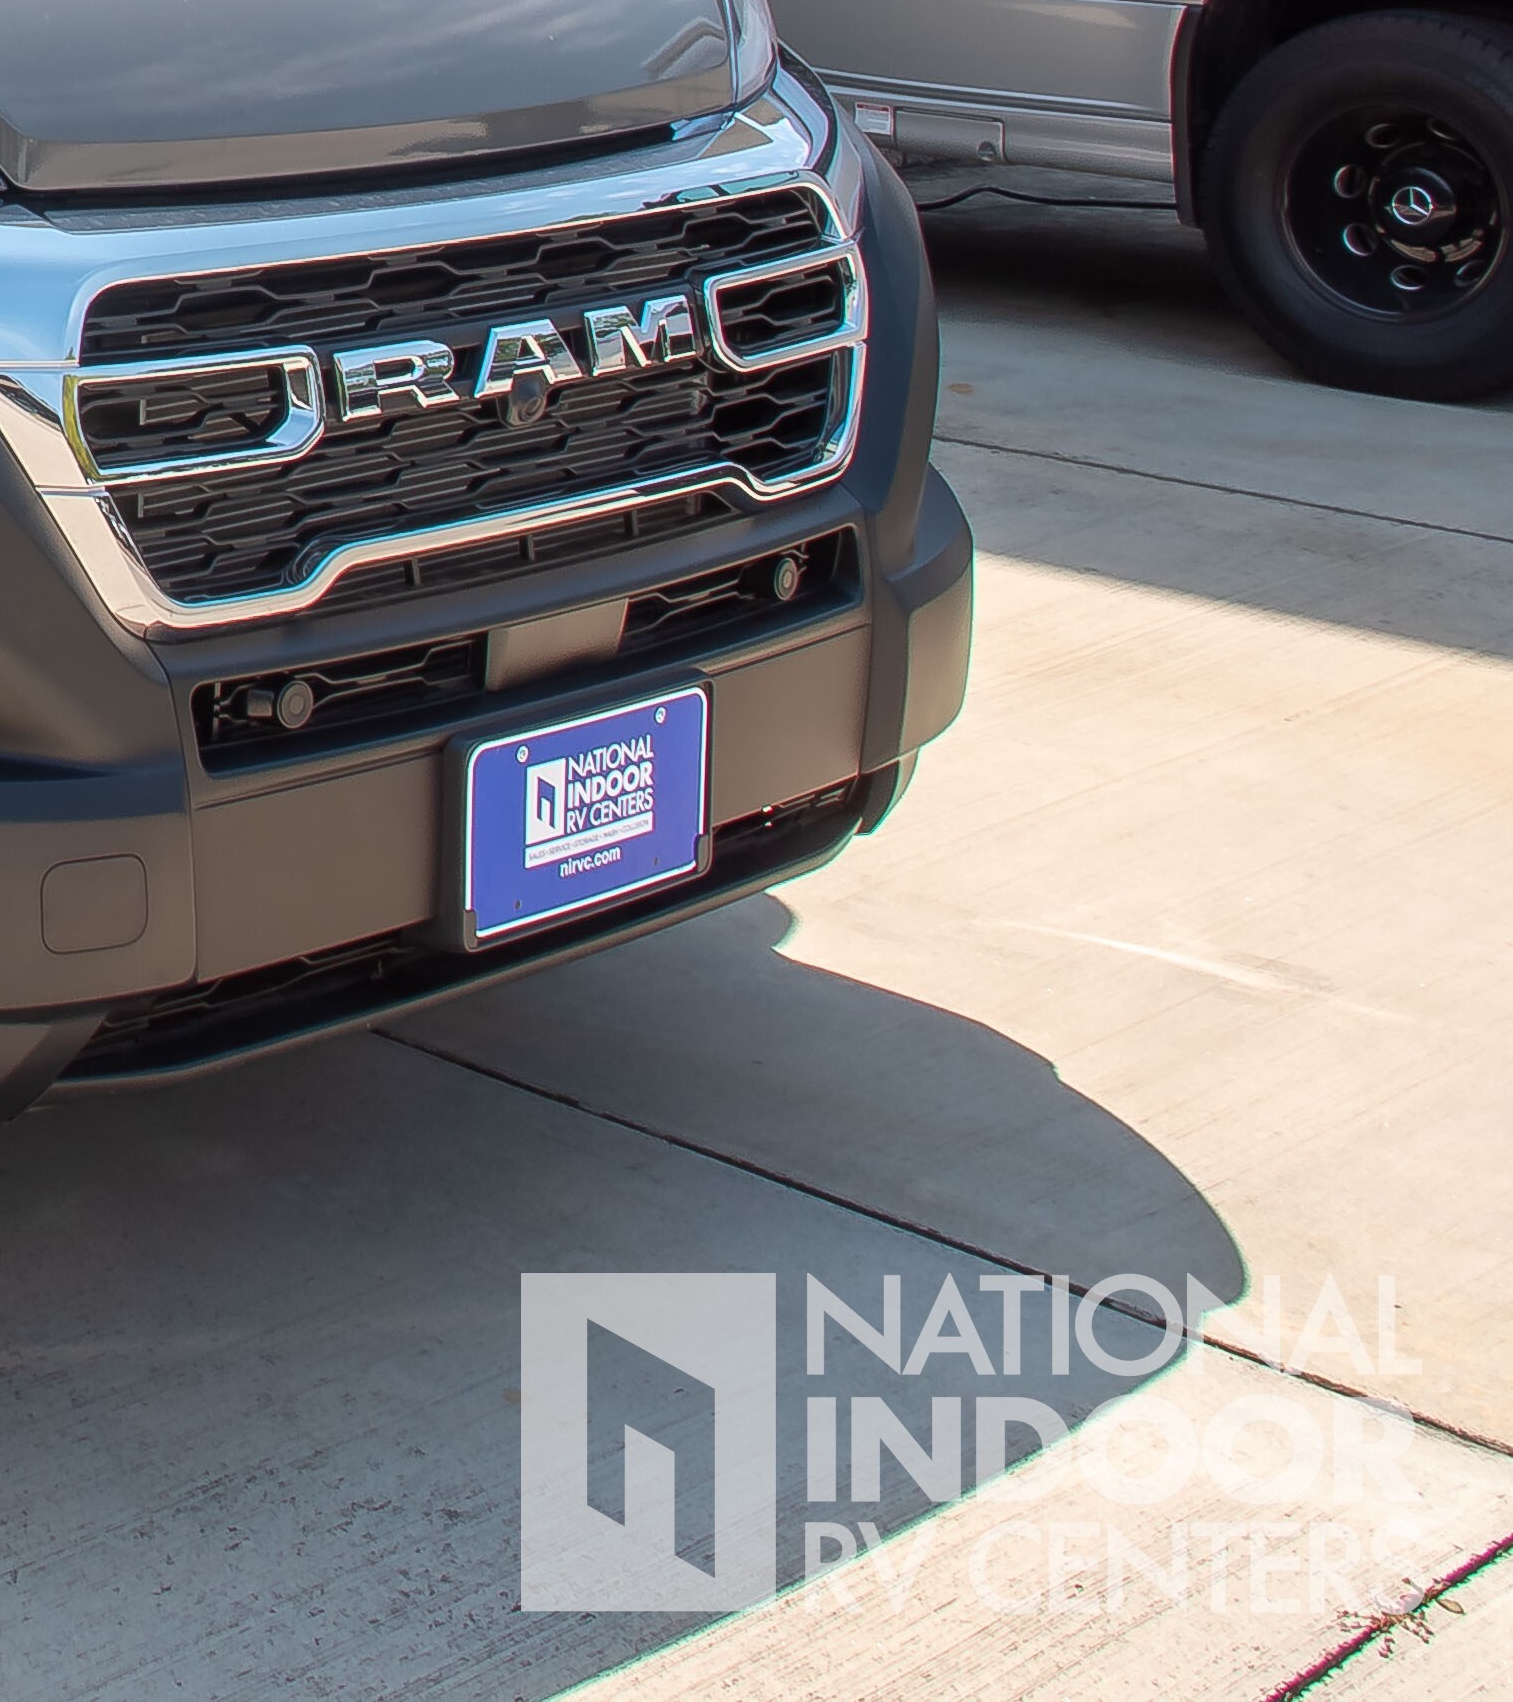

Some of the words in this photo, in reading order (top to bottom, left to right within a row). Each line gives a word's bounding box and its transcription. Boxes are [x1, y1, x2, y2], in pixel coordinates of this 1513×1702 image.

[334, 294, 698, 422] RAM
[568, 734, 654, 780] NATIONAL
[567, 761, 654, 809] INDOOR
[566, 807, 588, 834] RV
[589, 787, 655, 826] CENTERS
[559, 847, 621, 877] nirvc.com
